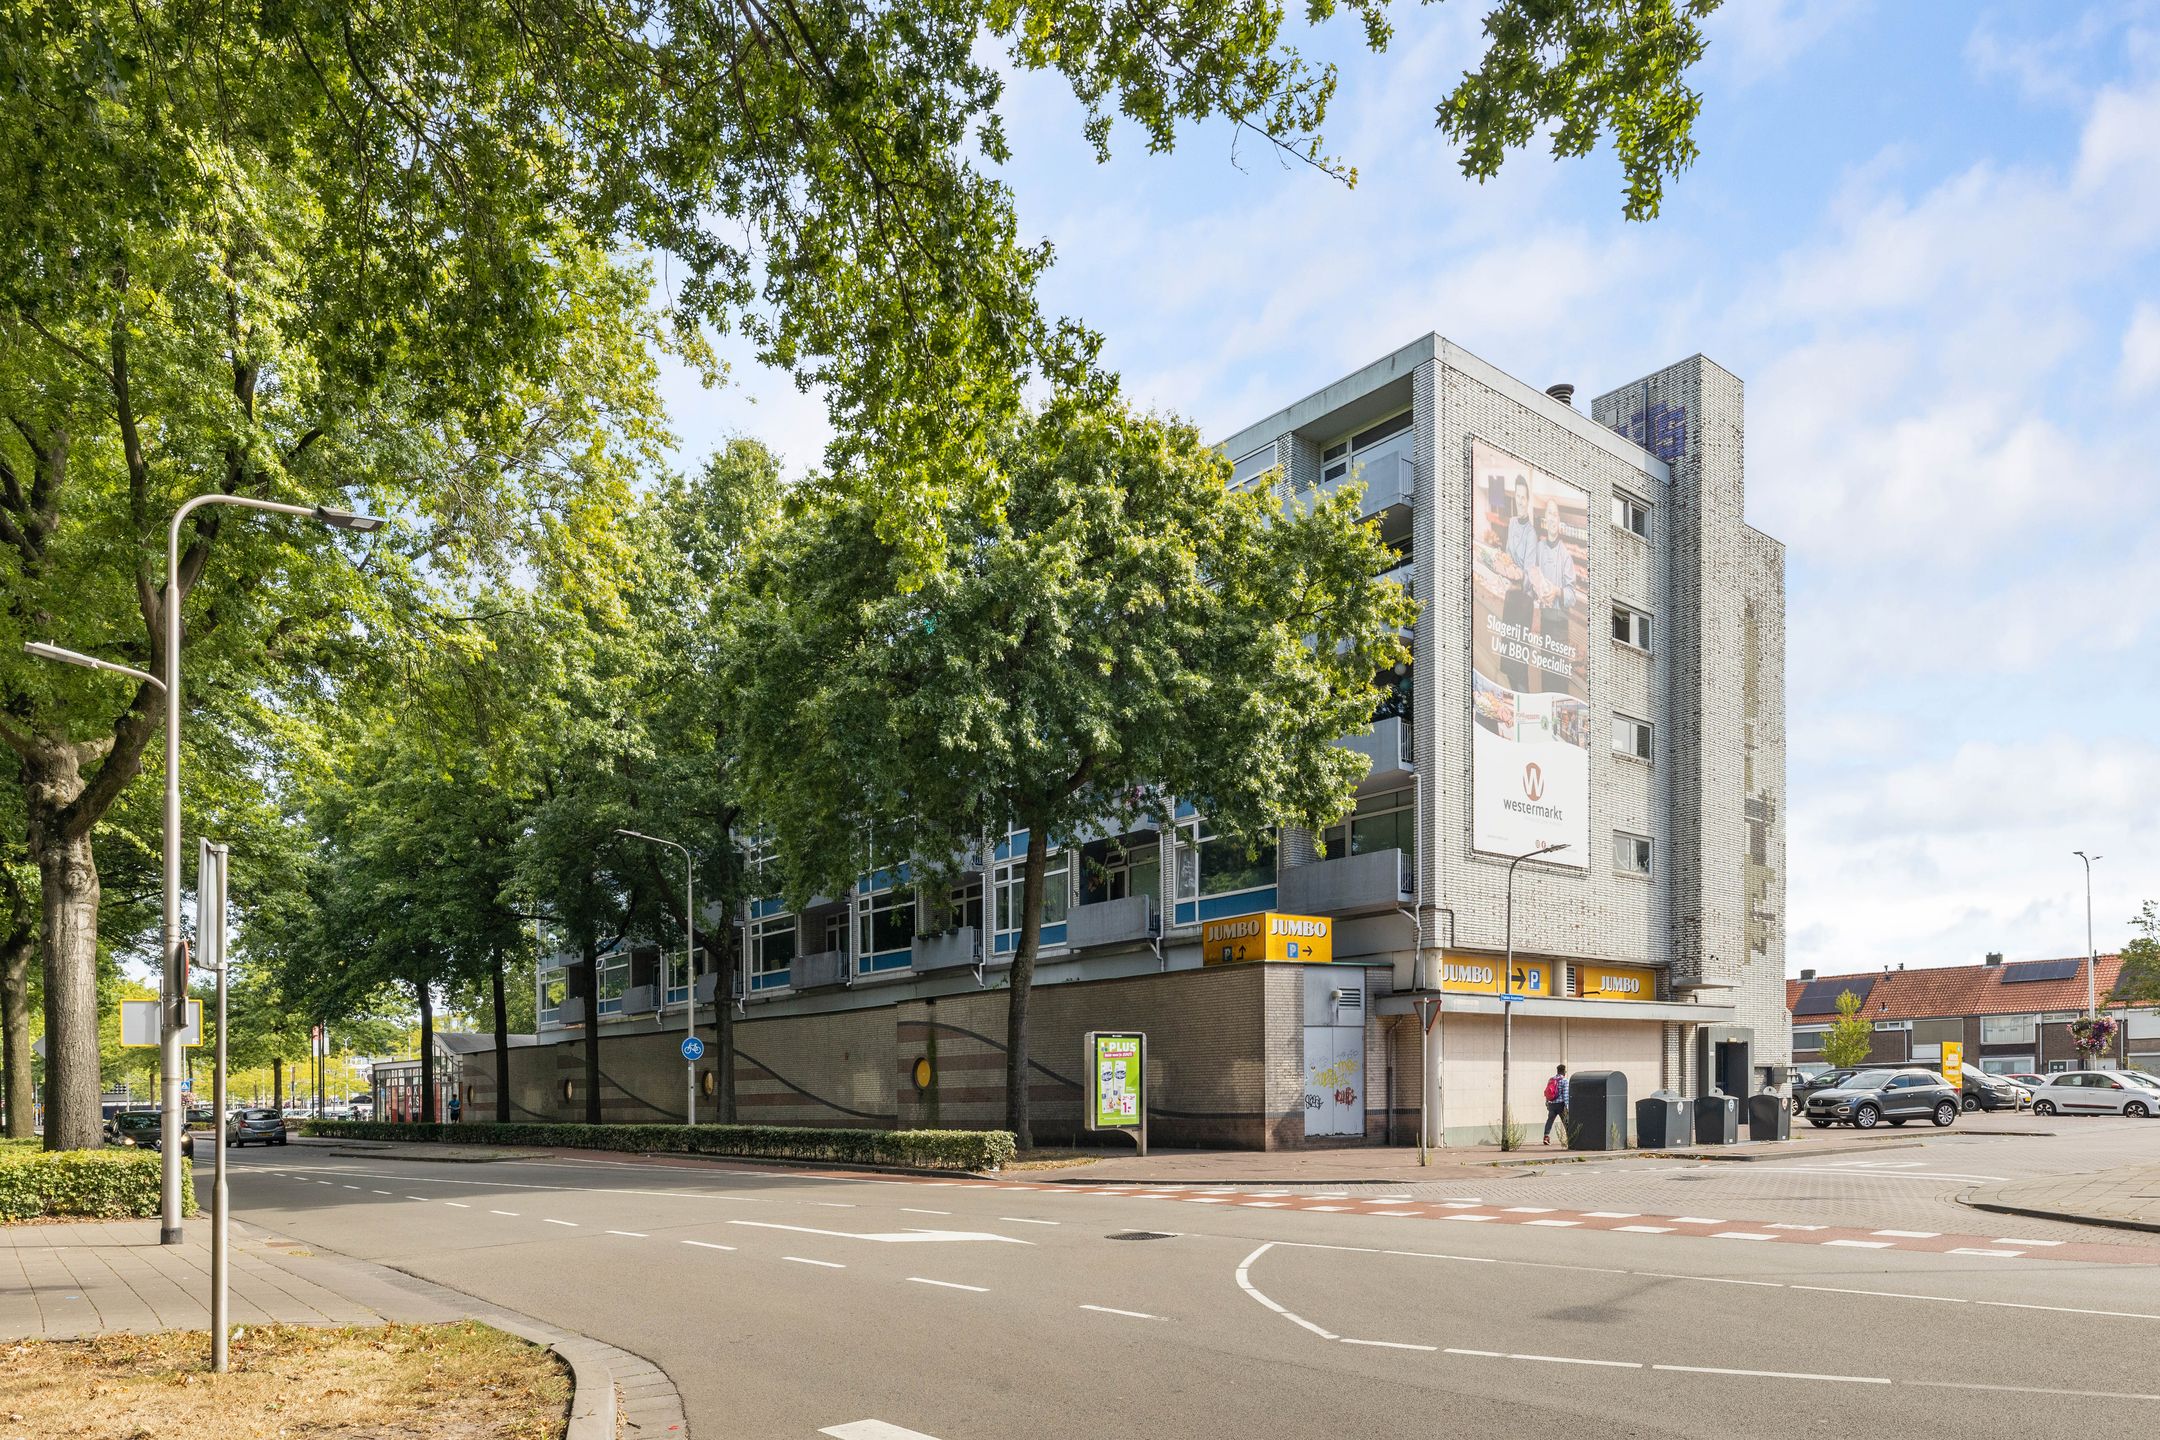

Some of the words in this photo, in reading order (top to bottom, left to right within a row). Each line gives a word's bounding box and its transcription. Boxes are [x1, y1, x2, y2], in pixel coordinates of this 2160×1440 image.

[1487, 614, 1521, 641] Slagerij
[1523, 625, 1543, 647] Fons
[1545, 635, 1577, 658] Pessers
[1491, 637, 1508, 654] Uw
[1509, 643, 1530, 665] BBQ
[1532, 650, 1573, 676] Specialist
[1503, 798, 1563, 821] westermarkt
[1208, 920, 1260, 942] JUMBO
[1271, 918, 1327, 938] JUMBO
[1441, 963, 1493, 984] JUMBO
[1600, 975, 1640, 993] JUMBO
[1109, 1042, 1137, 1053] PLUS
